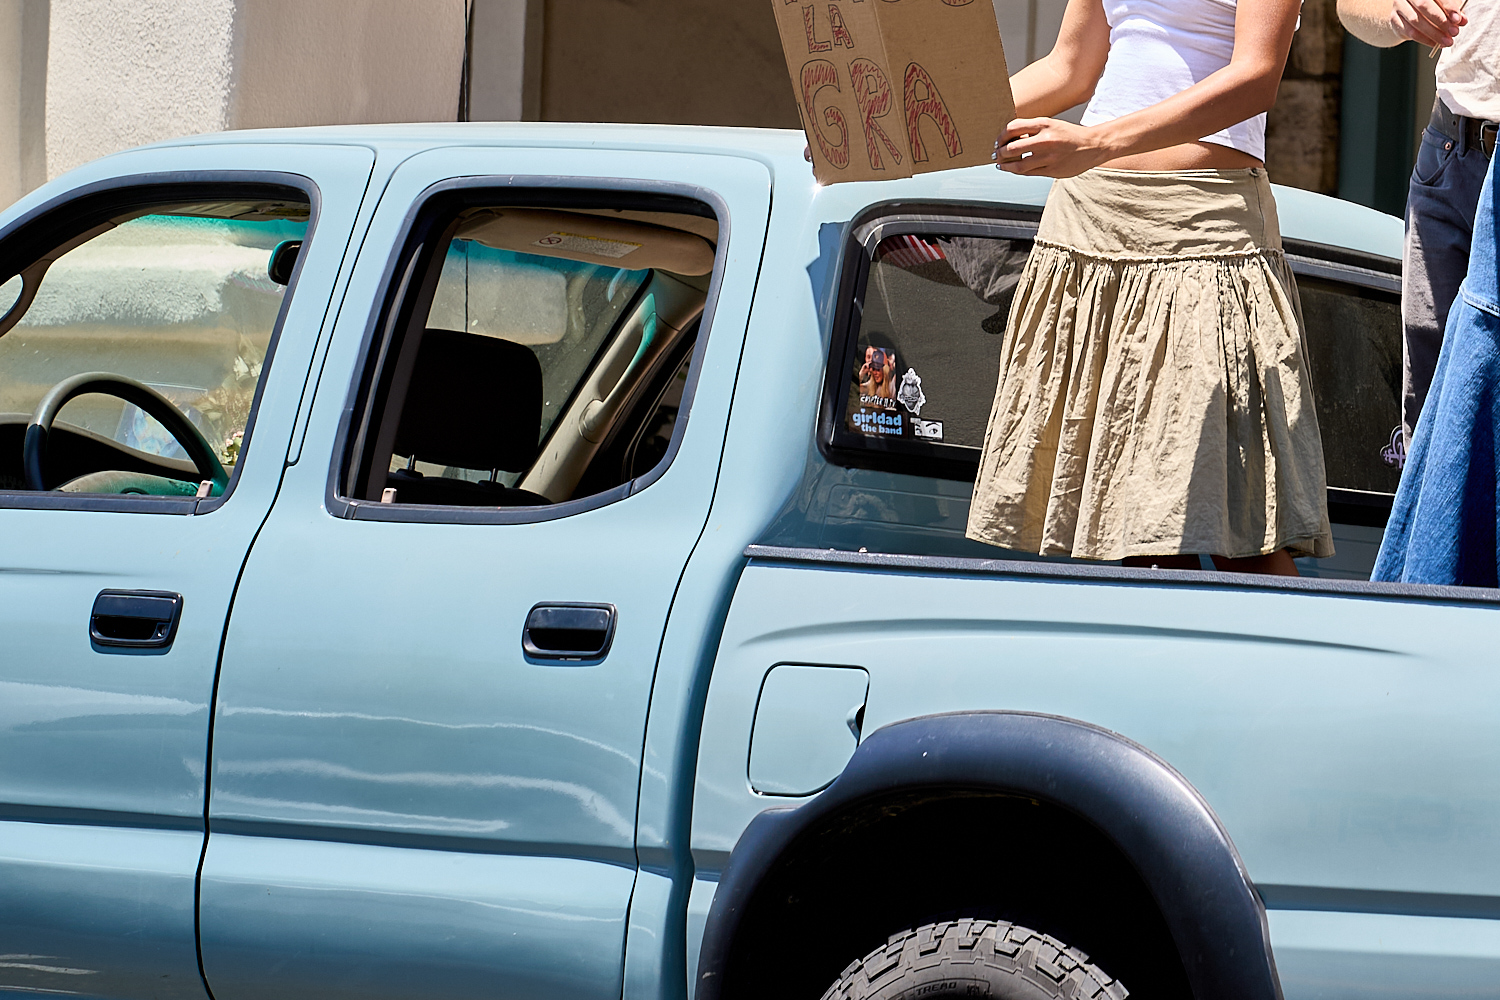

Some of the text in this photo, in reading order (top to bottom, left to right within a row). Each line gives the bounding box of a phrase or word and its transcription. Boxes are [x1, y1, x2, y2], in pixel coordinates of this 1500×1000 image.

[802, 4, 854, 54] LA
[852, 408, 902, 426] girldad
[861, 423, 902, 435] the band
